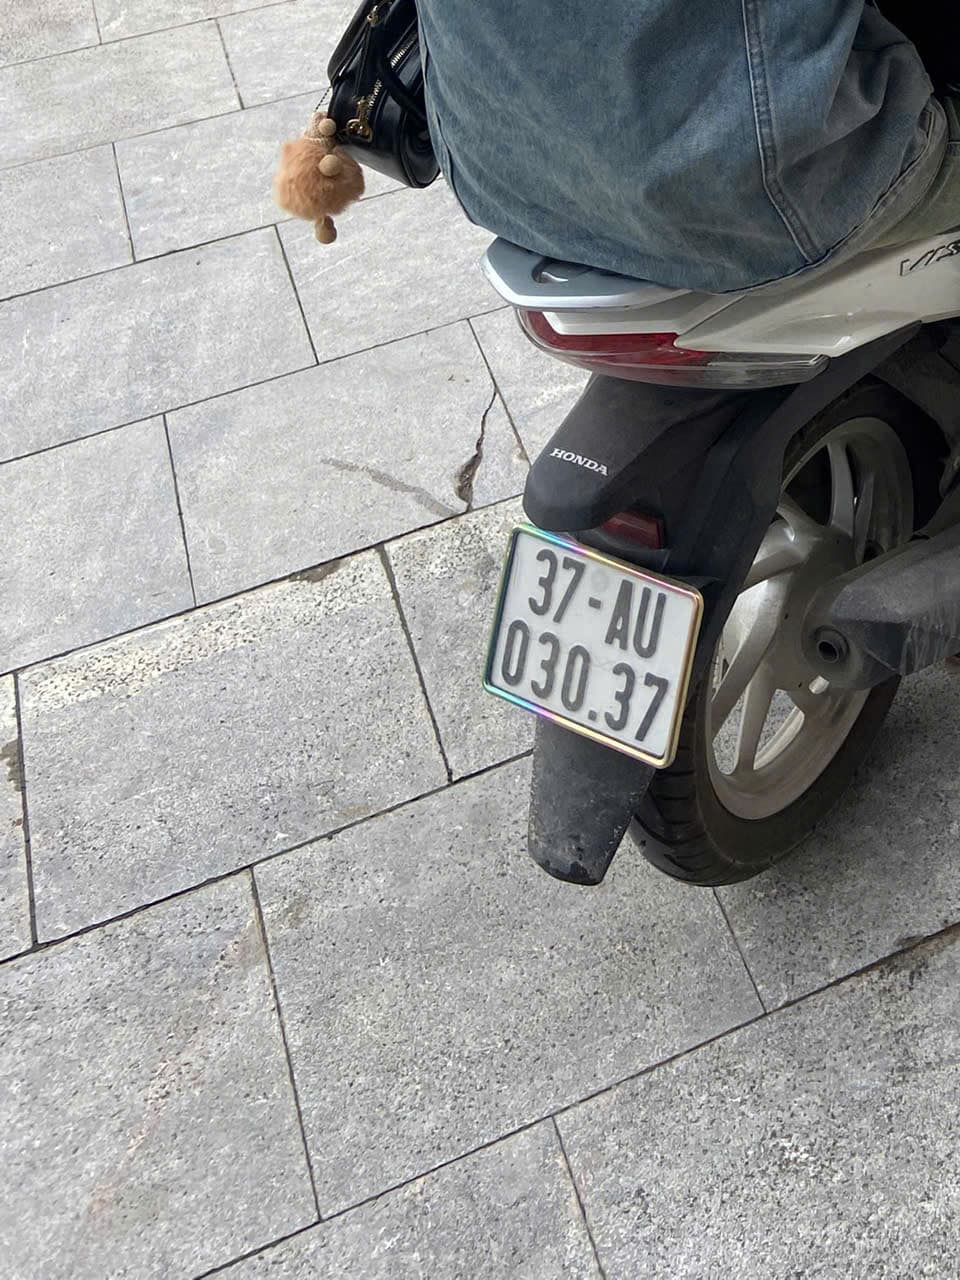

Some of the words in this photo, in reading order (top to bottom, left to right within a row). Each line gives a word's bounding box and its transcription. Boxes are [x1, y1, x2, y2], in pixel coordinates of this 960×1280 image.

[549, 447, 609, 477] HONDA
[528, 548, 666, 659] 37-AU
[502, 619, 669, 743] 030.37
